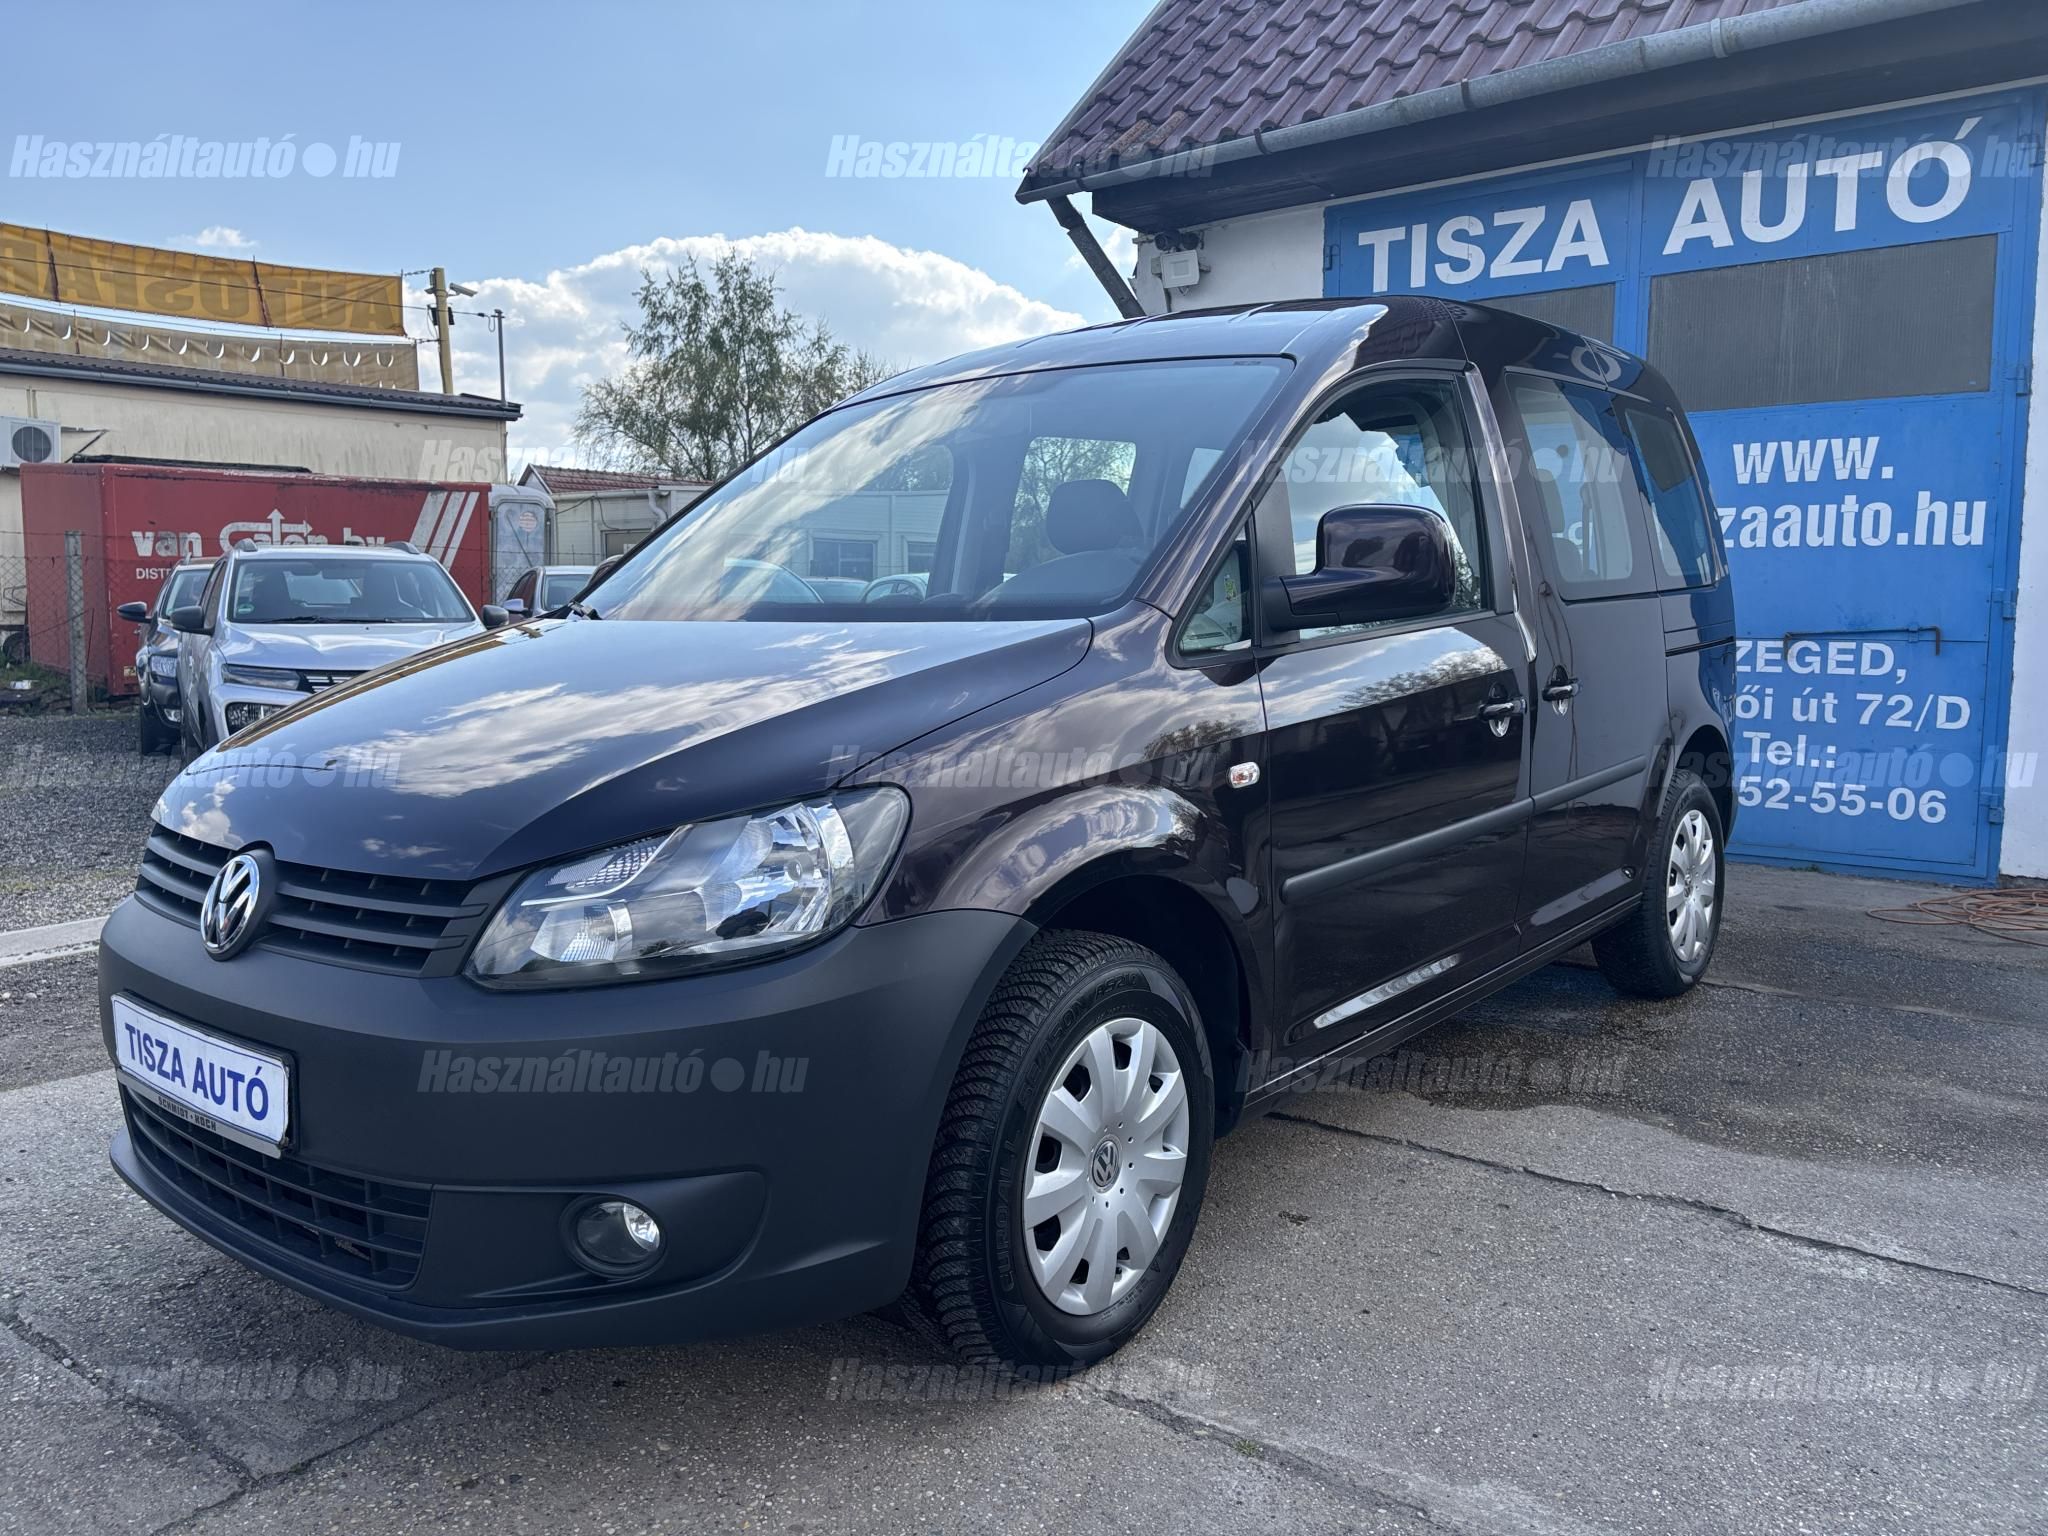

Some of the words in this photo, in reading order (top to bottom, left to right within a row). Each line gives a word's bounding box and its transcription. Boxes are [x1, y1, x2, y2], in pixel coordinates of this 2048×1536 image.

[1357, 199, 1610, 293] TISZA
[1661, 116, 1983, 256] AUTÓ
[1732, 436, 1895, 486] www.
[131, 530, 202, 557] van
[1791, 687, 1838, 723] út
[1855, 693, 1972, 732] 72/D
[1743, 731, 1838, 769] Tel.:
[1738, 775, 1948, 824] 52-55-06
[124, 1022, 187, 1088] TISZA
[192, 1057, 269, 1121] AUTÓ
